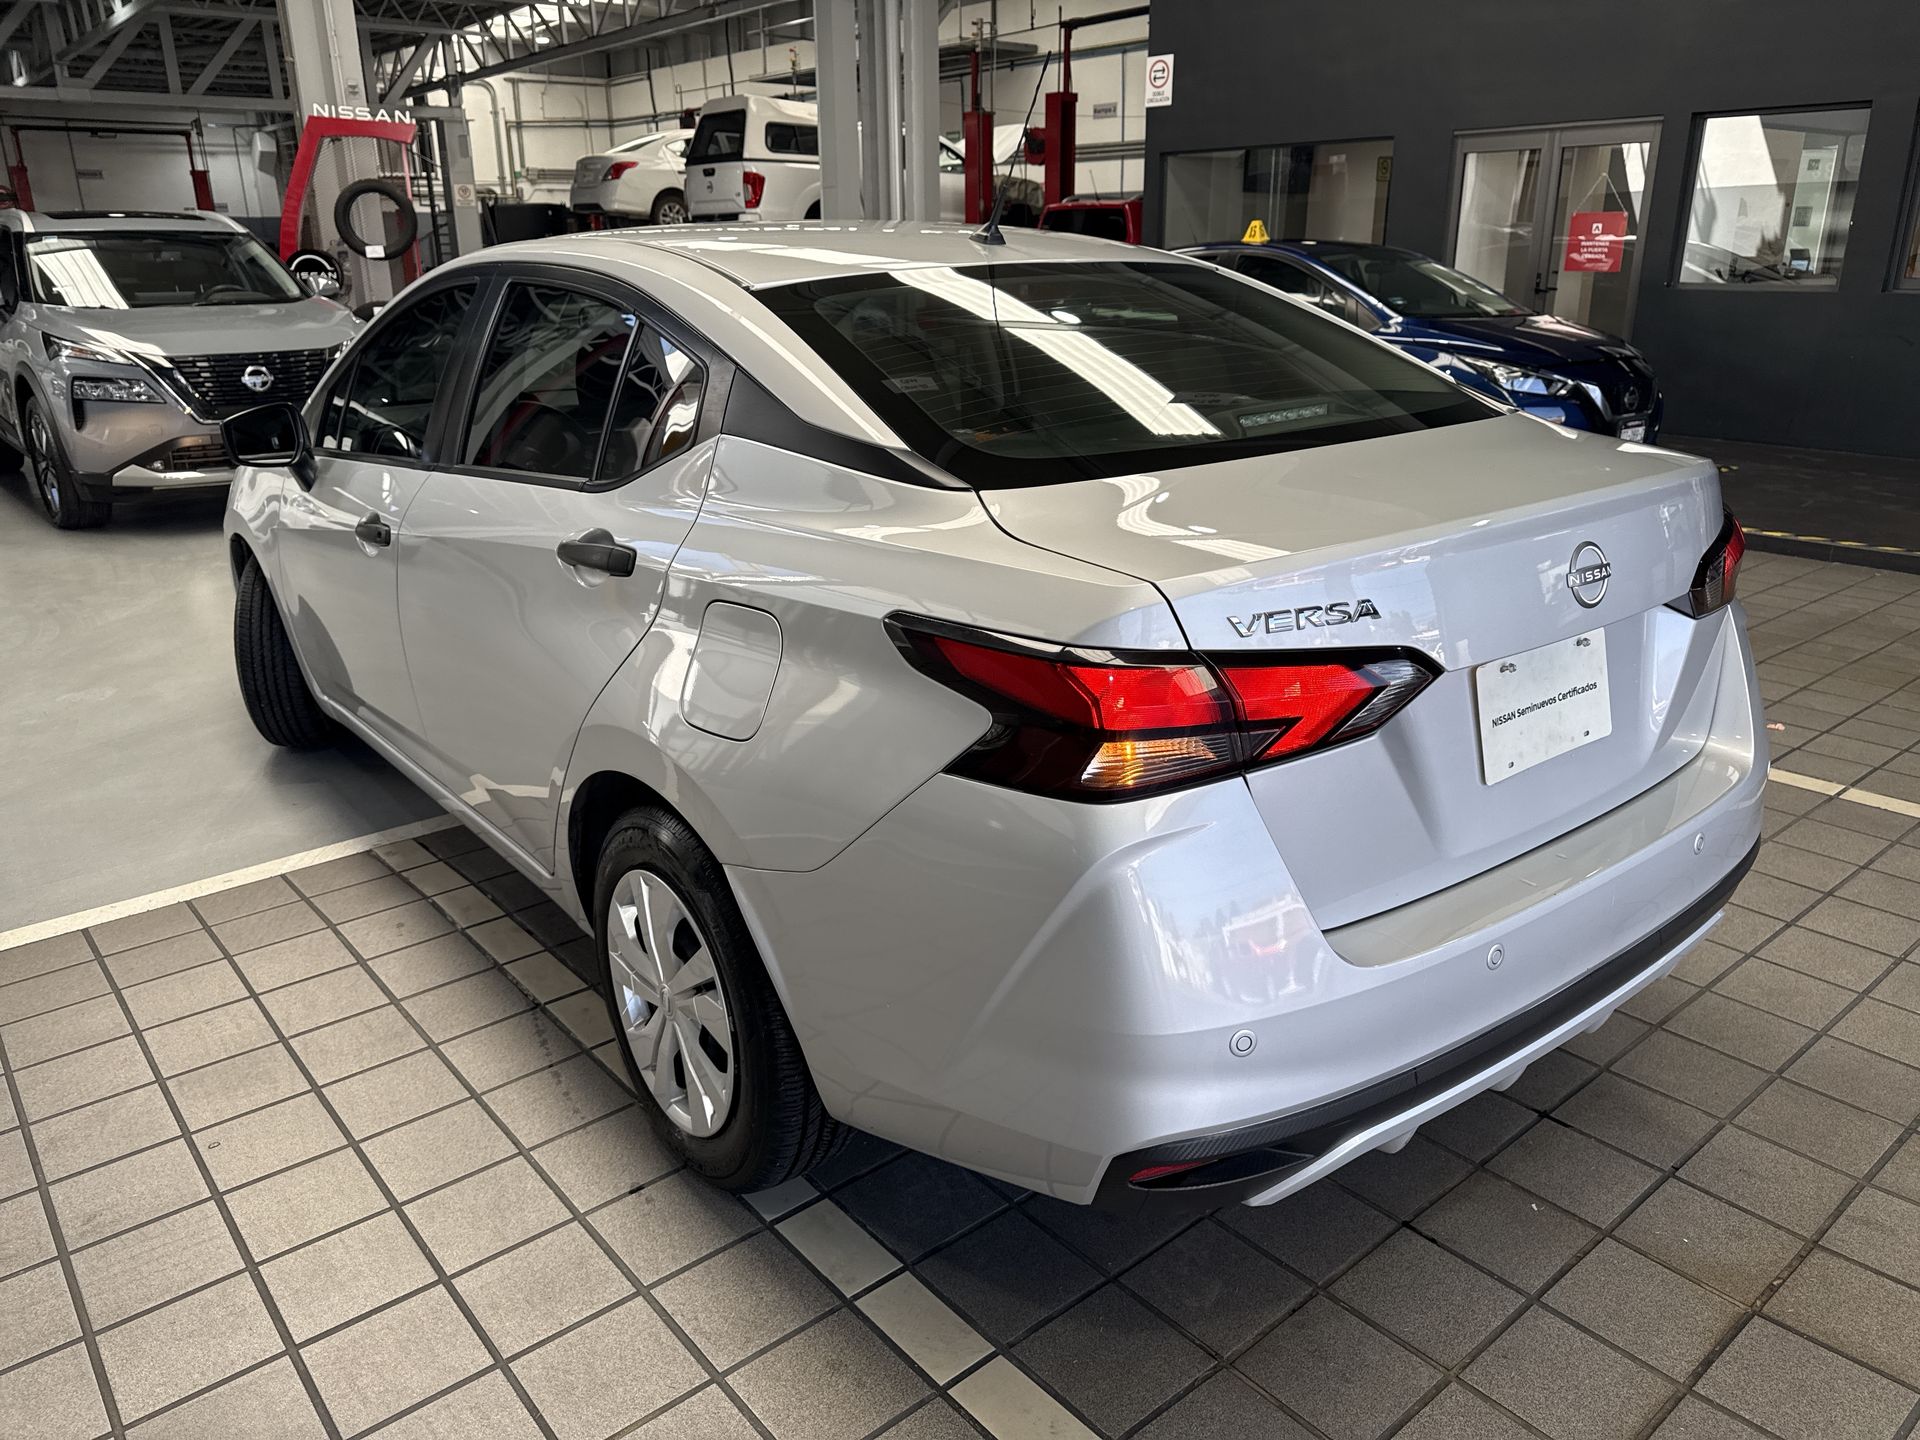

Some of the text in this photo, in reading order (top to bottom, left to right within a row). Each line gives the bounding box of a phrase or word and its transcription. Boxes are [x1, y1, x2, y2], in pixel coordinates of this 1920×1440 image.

[312, 102, 411, 125] NISSAN
[296, 271, 338, 280] ISSAN
[1569, 565, 1612, 586] NISSAN
[1226, 598, 1382, 638] VERSA
[1491, 681, 1598, 728] NISSAN Seminuevos Certificados
